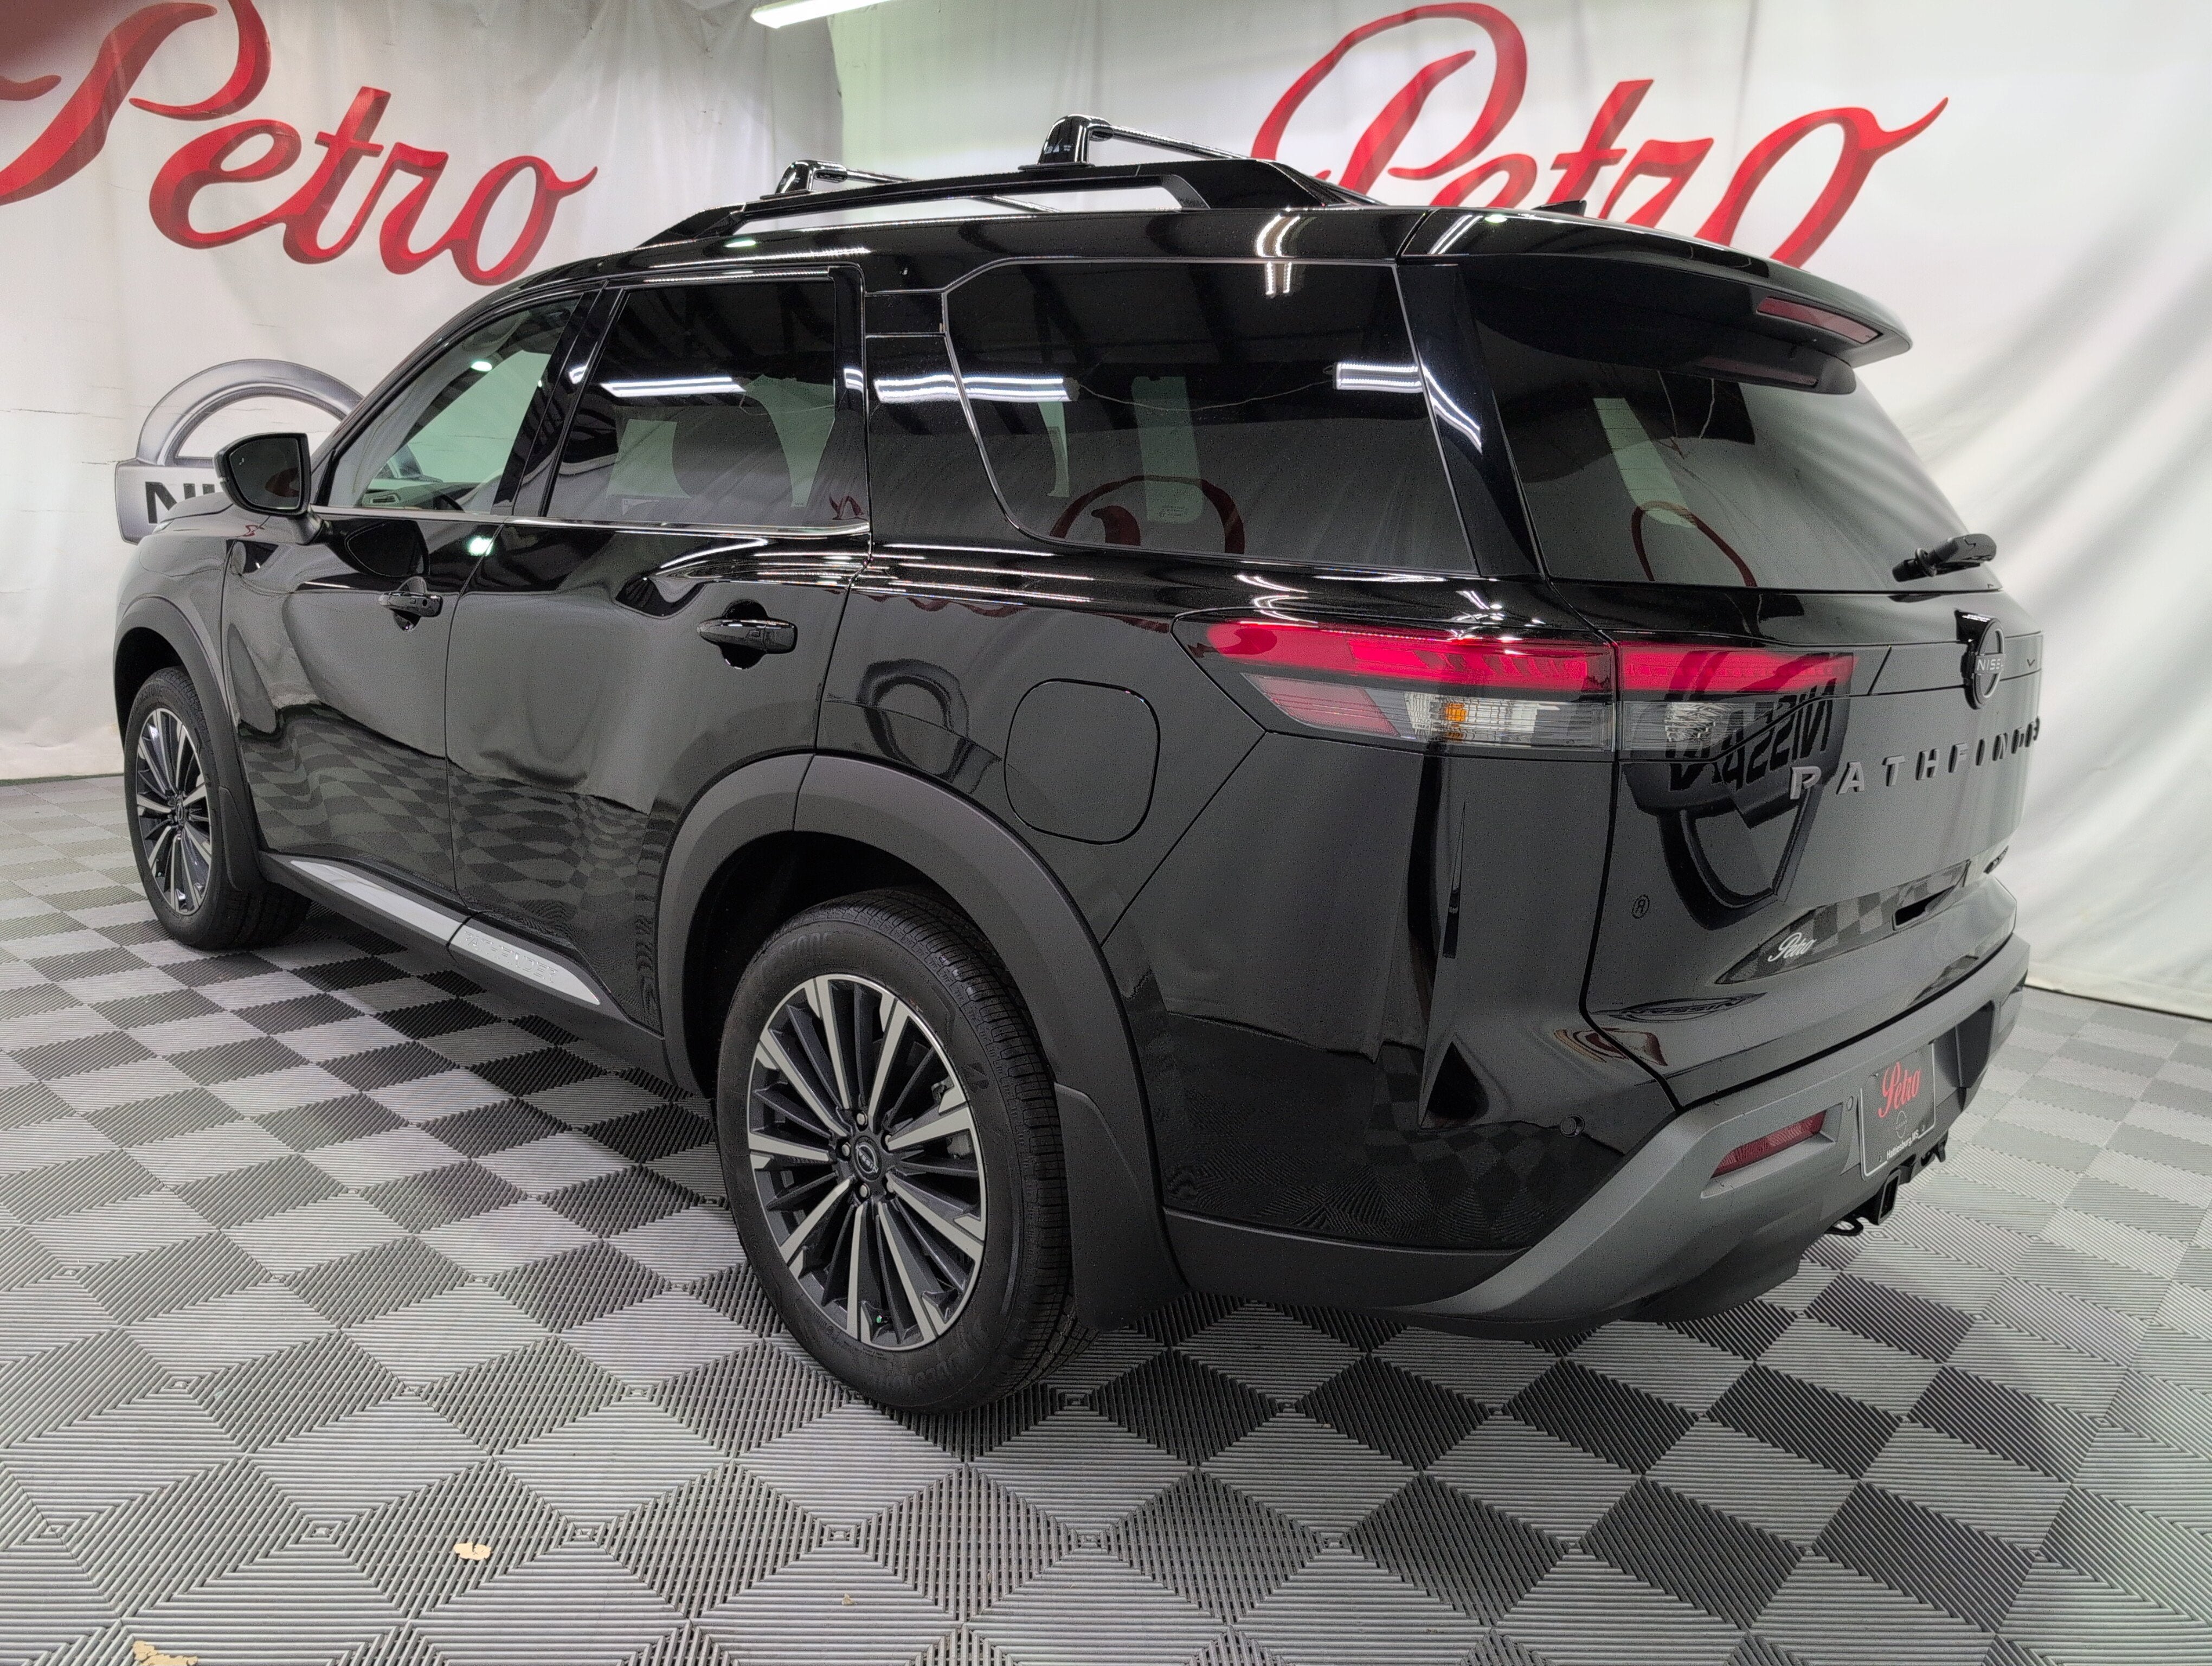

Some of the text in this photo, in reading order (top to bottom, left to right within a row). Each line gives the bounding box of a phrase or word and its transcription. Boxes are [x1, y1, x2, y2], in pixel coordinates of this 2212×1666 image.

[0, 0, 597, 285] Petro
[1790, 716, 2040, 800] PATHFINDE
[1767, 932, 1817, 962] Petro
[1878, 1061, 1921, 1118] Petro
